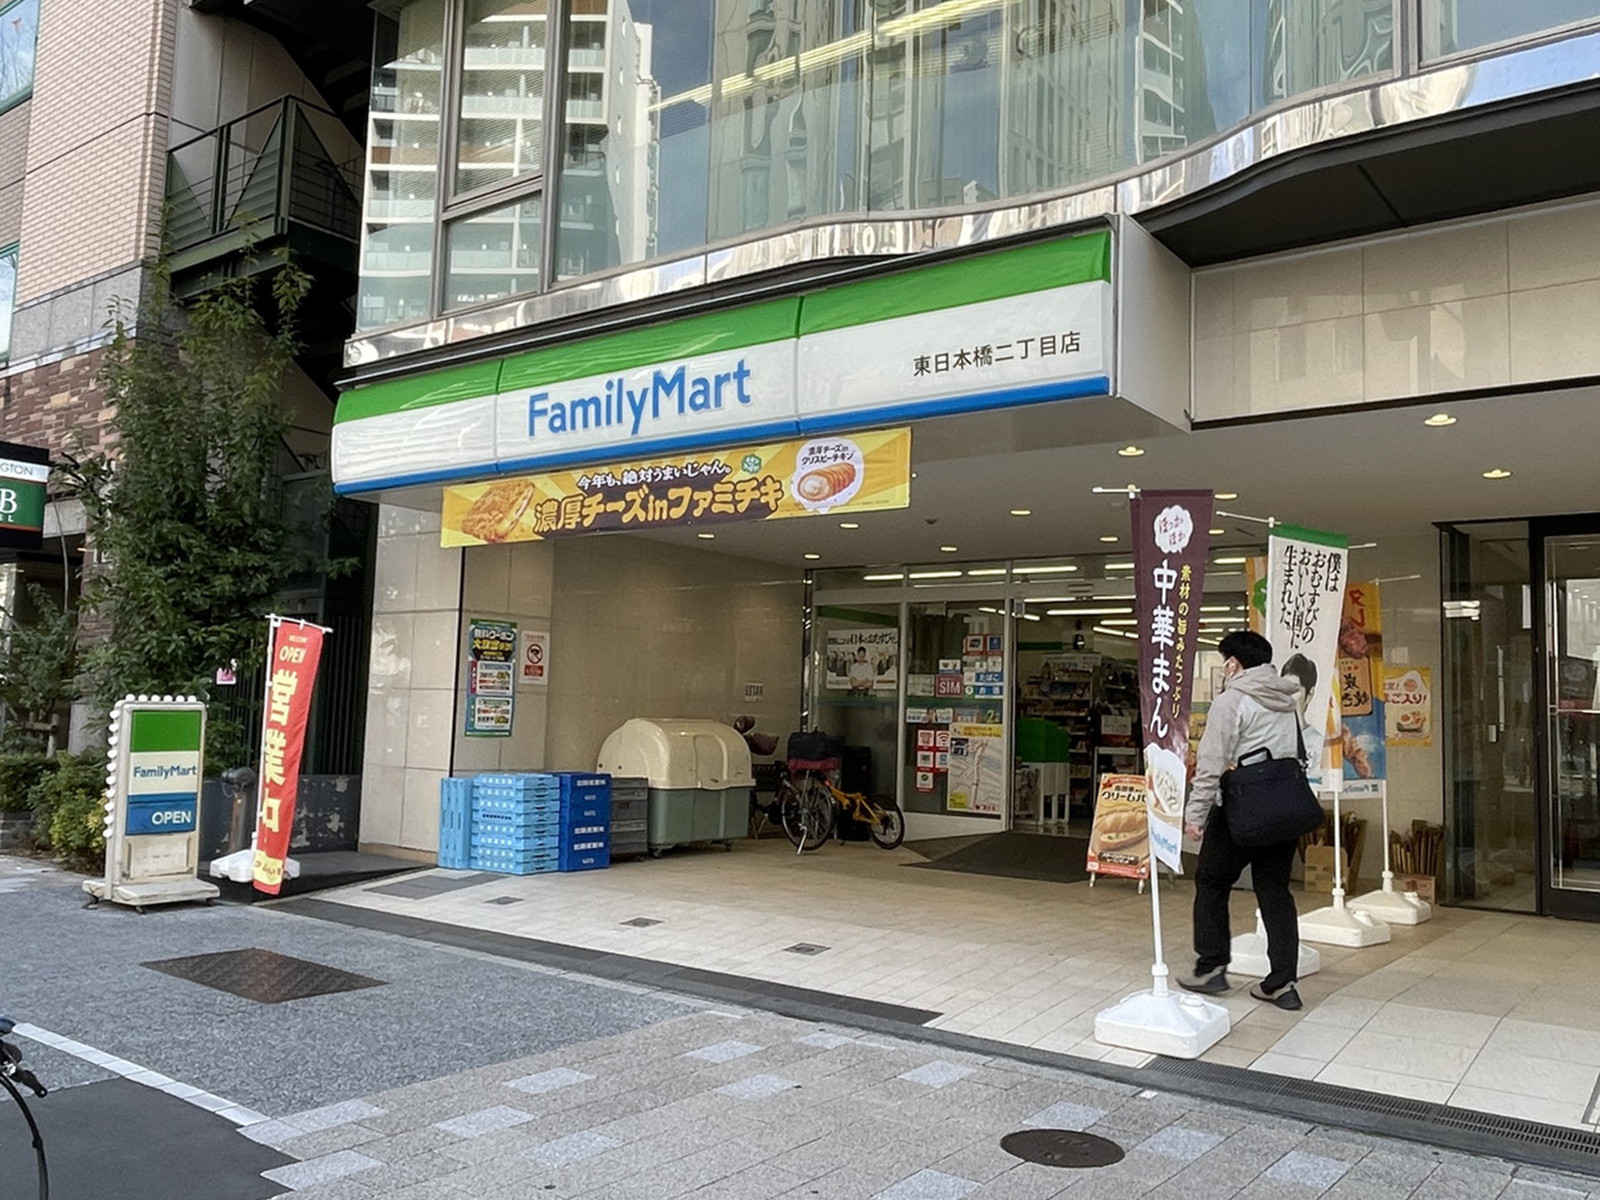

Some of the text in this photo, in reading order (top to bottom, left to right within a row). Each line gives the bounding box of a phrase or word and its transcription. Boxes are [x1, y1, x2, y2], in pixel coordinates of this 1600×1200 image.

[913, 330, 1081, 377] 東日本橋二丁目店
[528, 358, 751, 438] FamilyMart
[577, 459, 732, 490] 今年も、絶対うまいじゃん。
[533, 476, 784, 533] 濃厚チーズinファミチキ
[1280, 544, 1298, 631] 生まれた。
[1302, 550, 1327, 644] おむすびの
[1325, 551, 1342, 593] 僕は
[1290, 547, 1313, 650] おいしい国に
[279, 645, 307, 664] OPEN
[1150, 559, 1178, 739] 中華まん
[1171, 564, 1192, 720] 素材の旨みたっぷり
[940, 681, 960, 694] SIM
[133, 765, 198, 780] FamilyMart
[152, 811, 191, 825] OPEN
